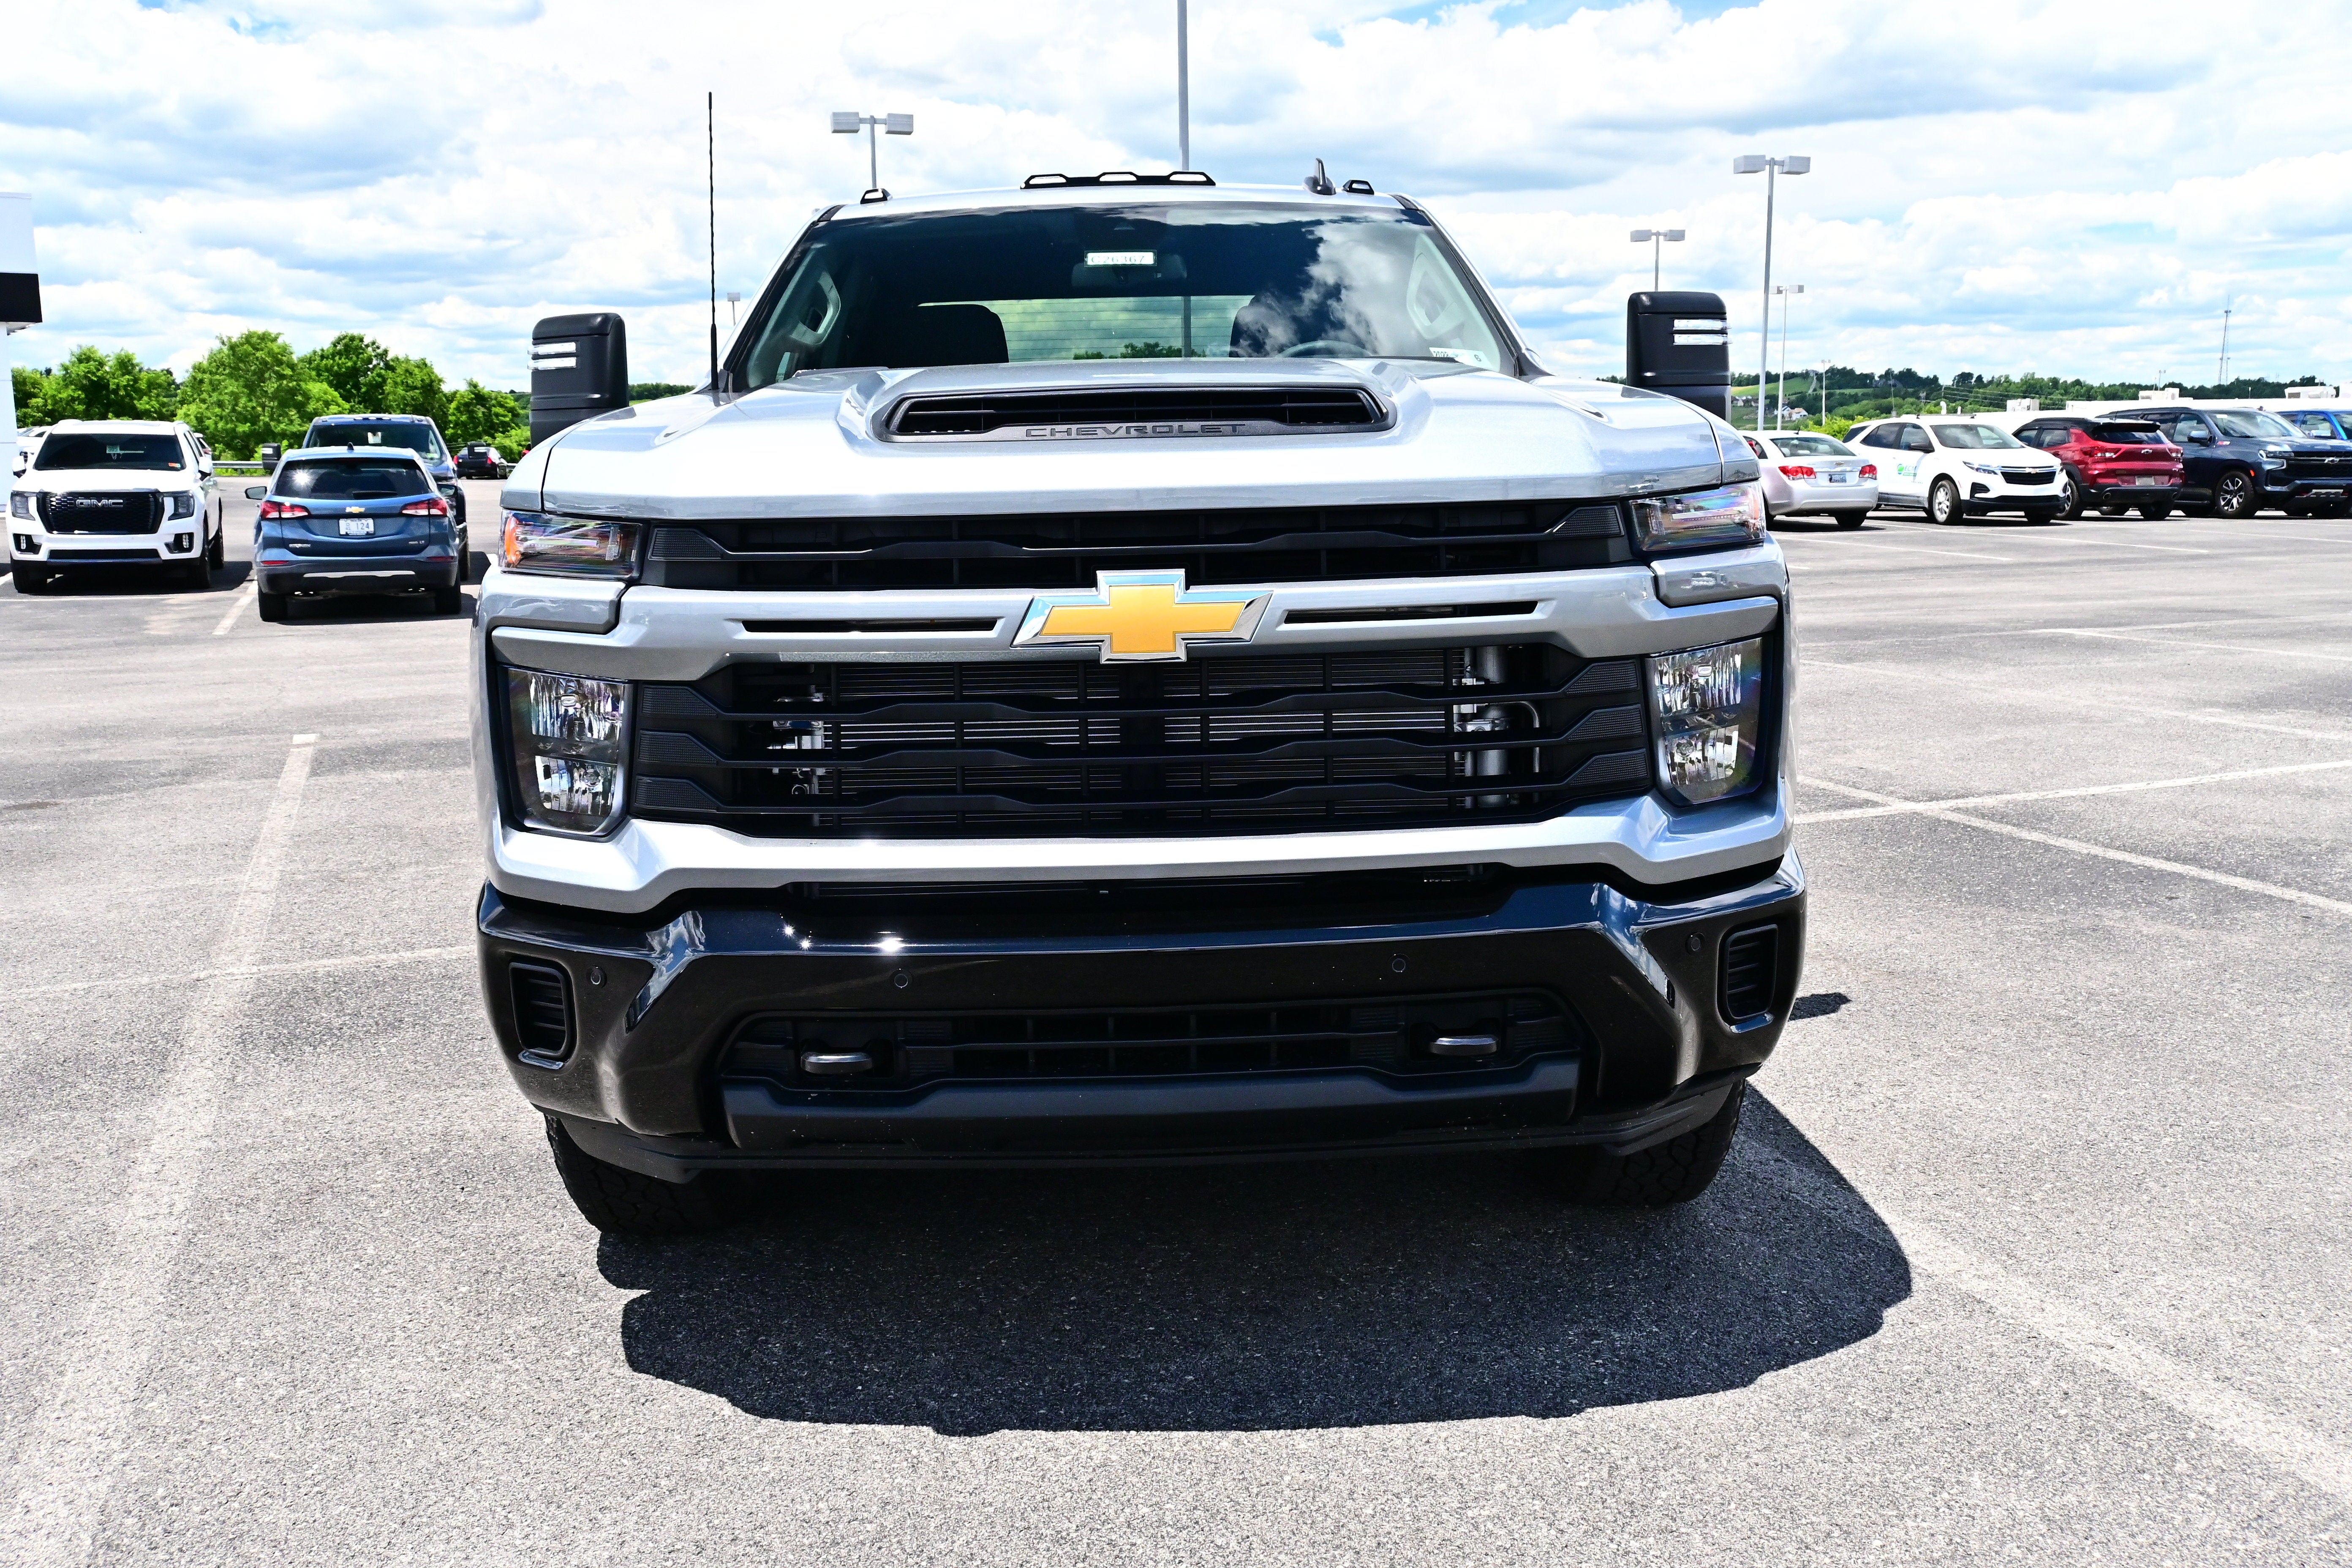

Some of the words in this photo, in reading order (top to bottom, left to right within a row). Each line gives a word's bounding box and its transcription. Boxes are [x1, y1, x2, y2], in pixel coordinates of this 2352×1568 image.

[1474, 354, 1482, 362] 6
[1026, 424, 1246, 438] CHEVROLET
[76, 499, 123, 508] GMC
